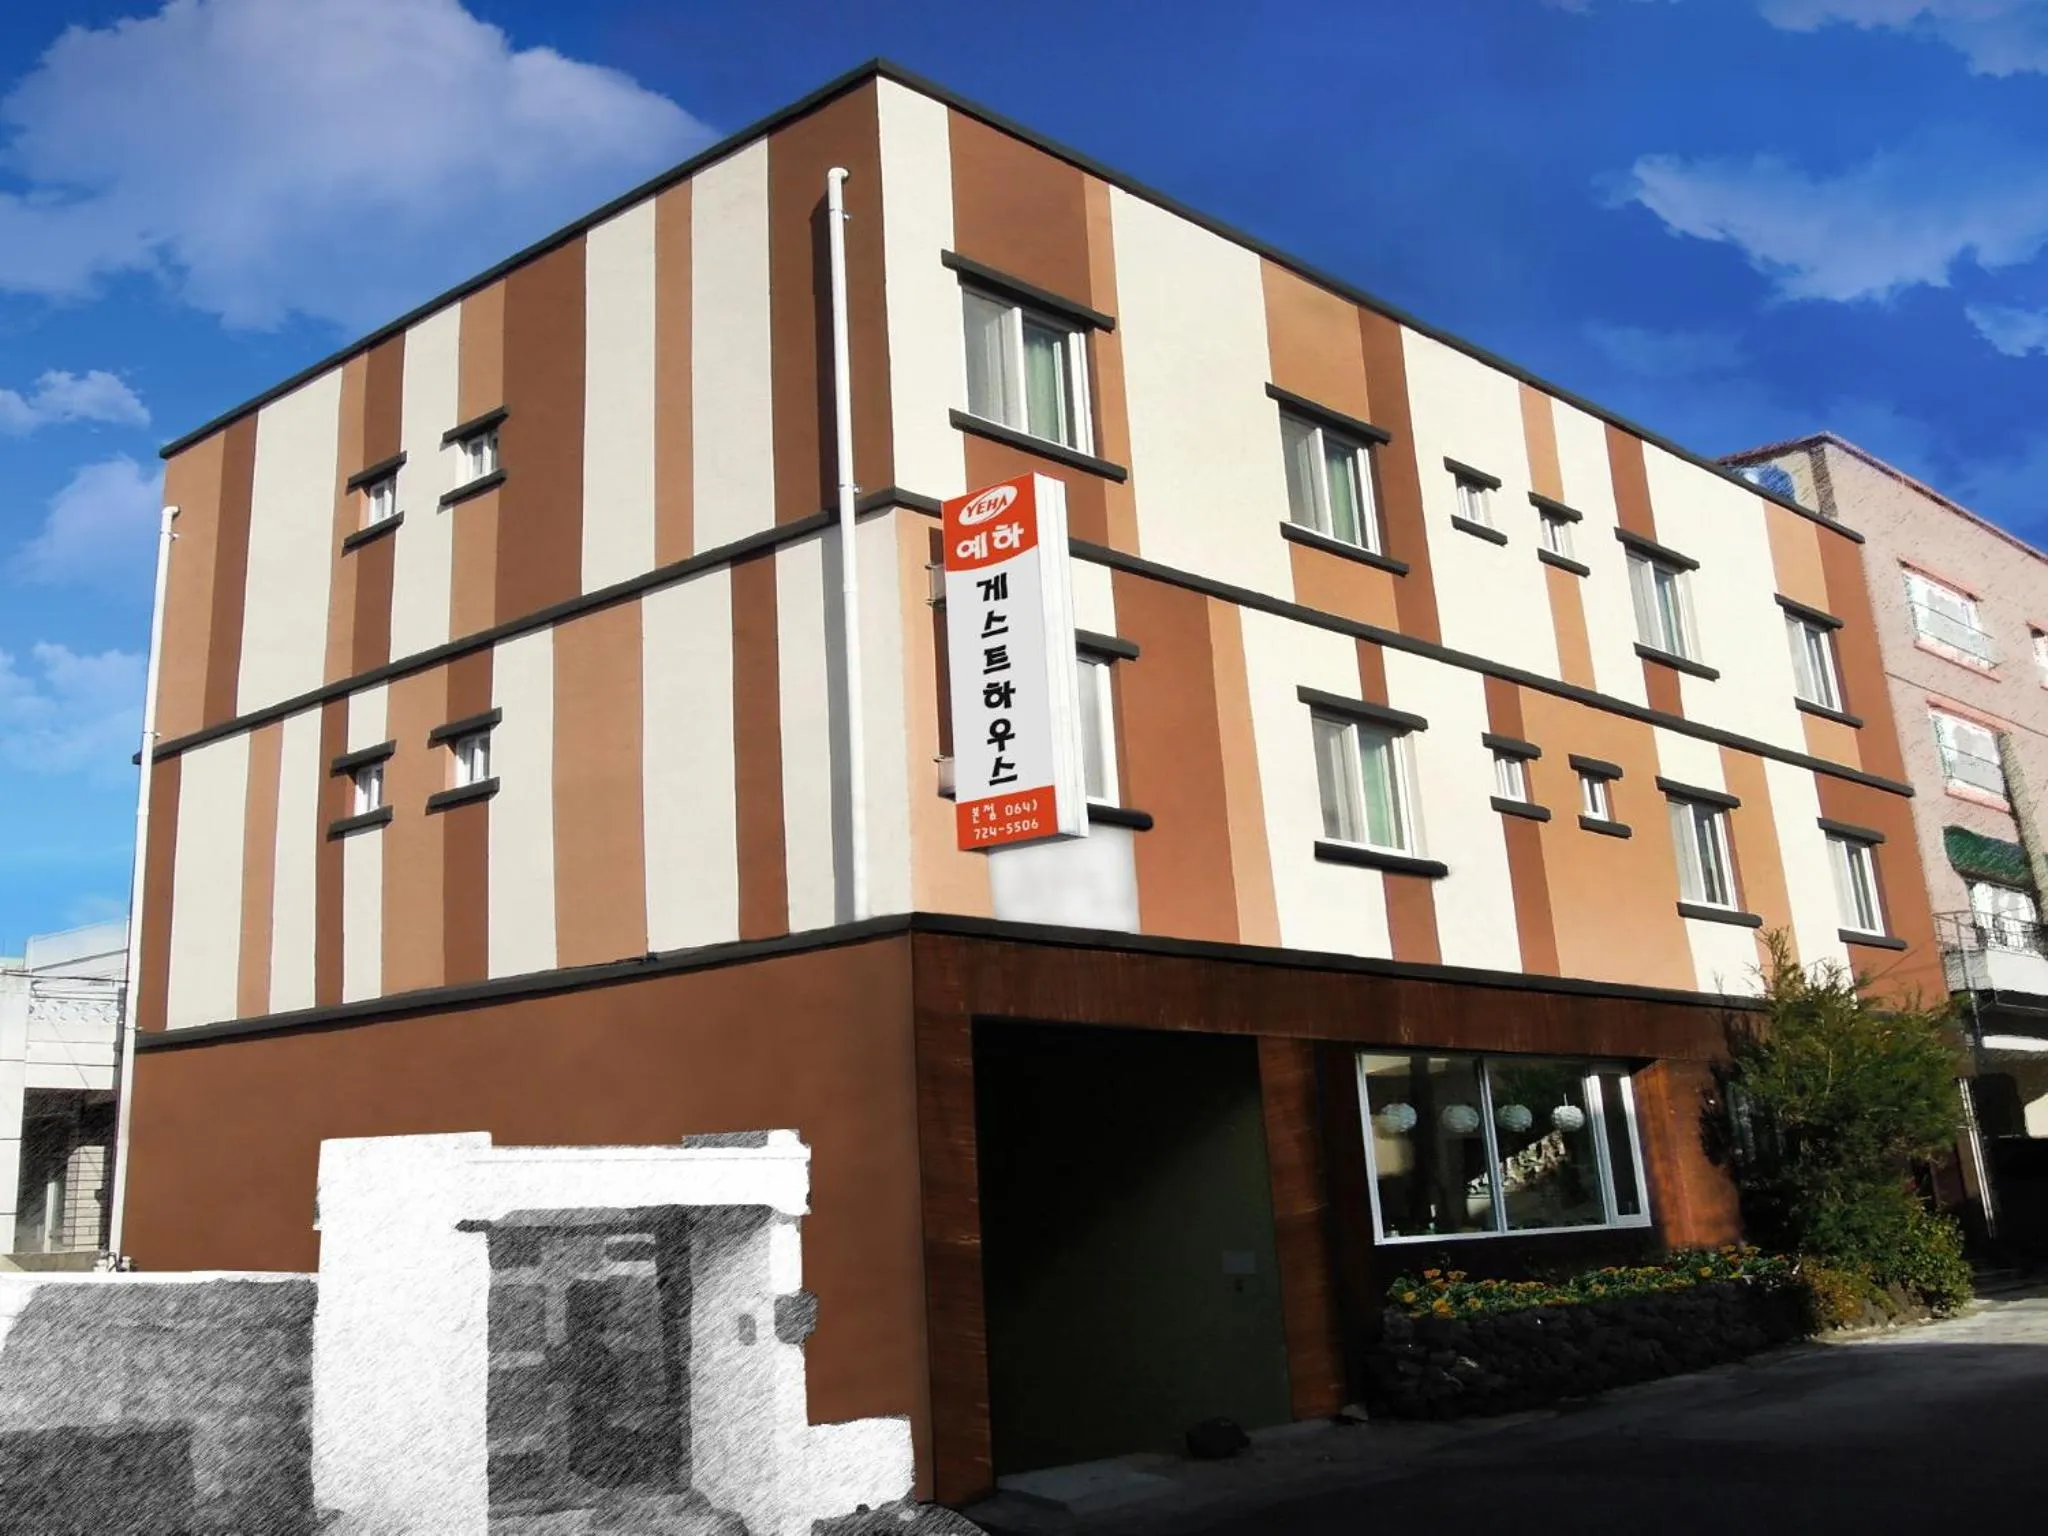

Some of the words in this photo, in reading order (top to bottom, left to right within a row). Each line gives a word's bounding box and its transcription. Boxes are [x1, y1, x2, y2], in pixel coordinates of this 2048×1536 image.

[966, 496, 1008, 518] YEHA
[956, 521, 1025, 560] 예하
[976, 572, 1018, 786] 게스트하우스
[1004, 798, 1038, 816] 064)
[973, 818, 1039, 840] 724-5506
